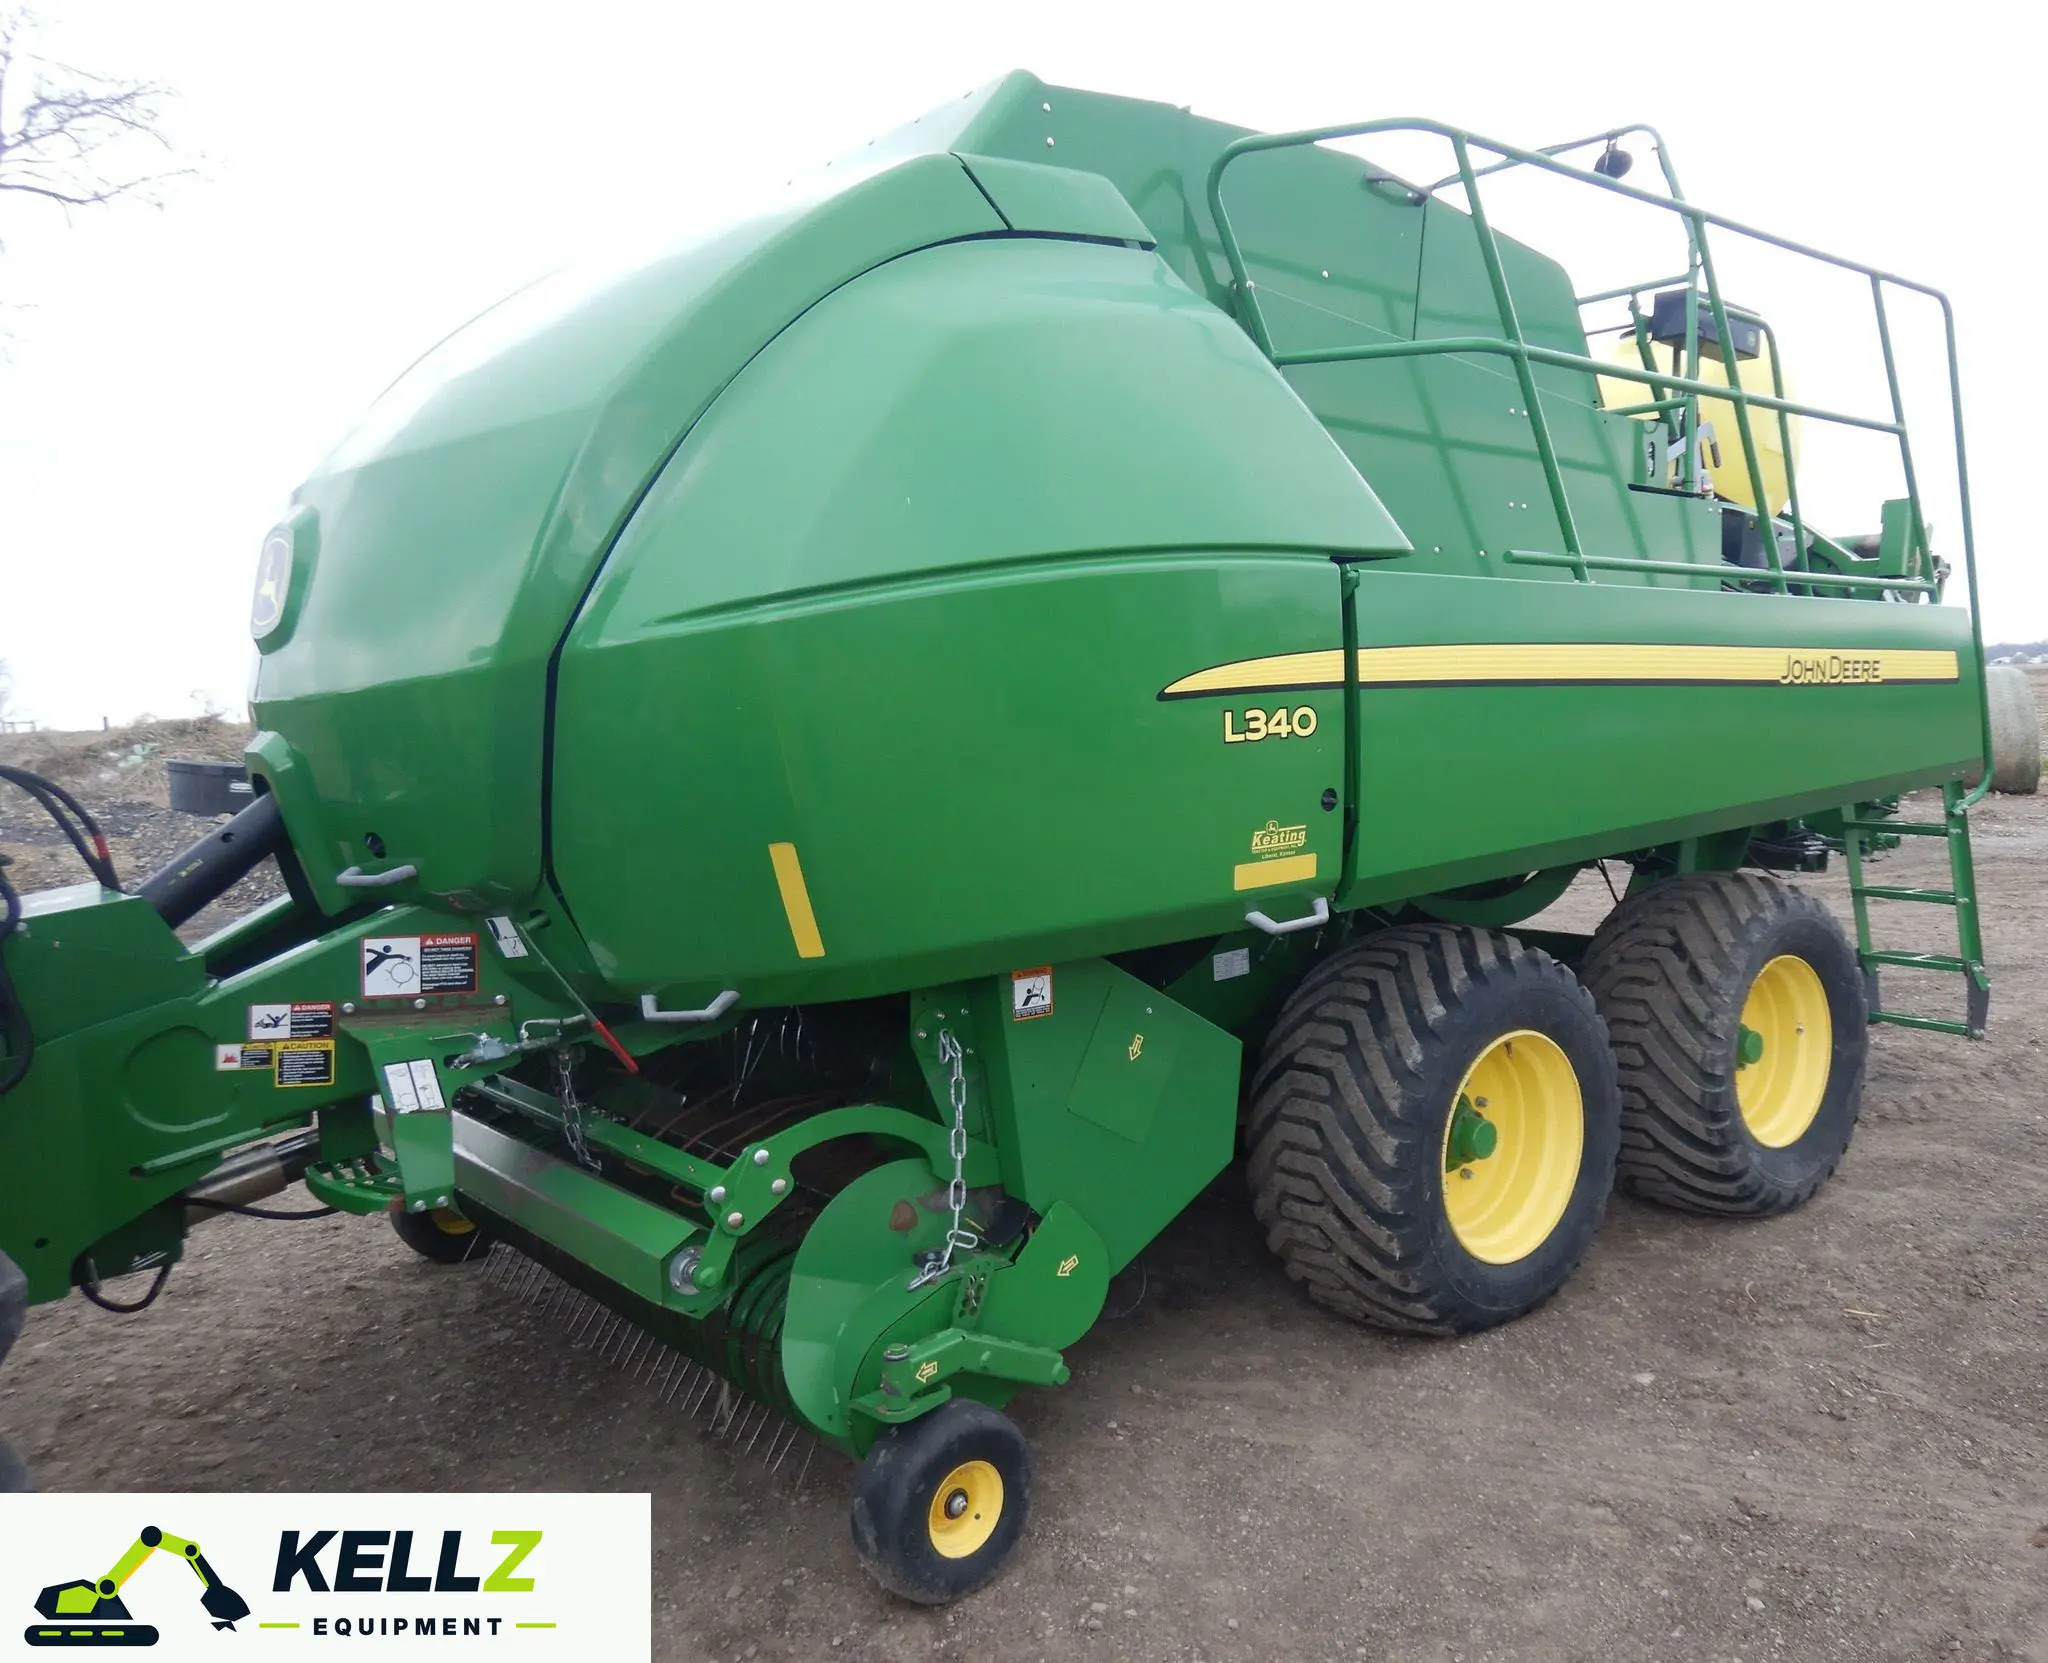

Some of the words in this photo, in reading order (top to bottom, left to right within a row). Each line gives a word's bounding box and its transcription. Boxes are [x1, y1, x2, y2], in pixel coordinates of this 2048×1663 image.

[1781, 654, 1827, 682] JOHN
[1829, 655, 1882, 681] DEERE
[1223, 704, 1318, 744] L340
[1252, 830, 1306, 847] Keating
[436, 936, 472, 945] DANGER
[301, 1003, 331, 1011] DANGER
[290, 1042, 329, 1050] CAUTION
